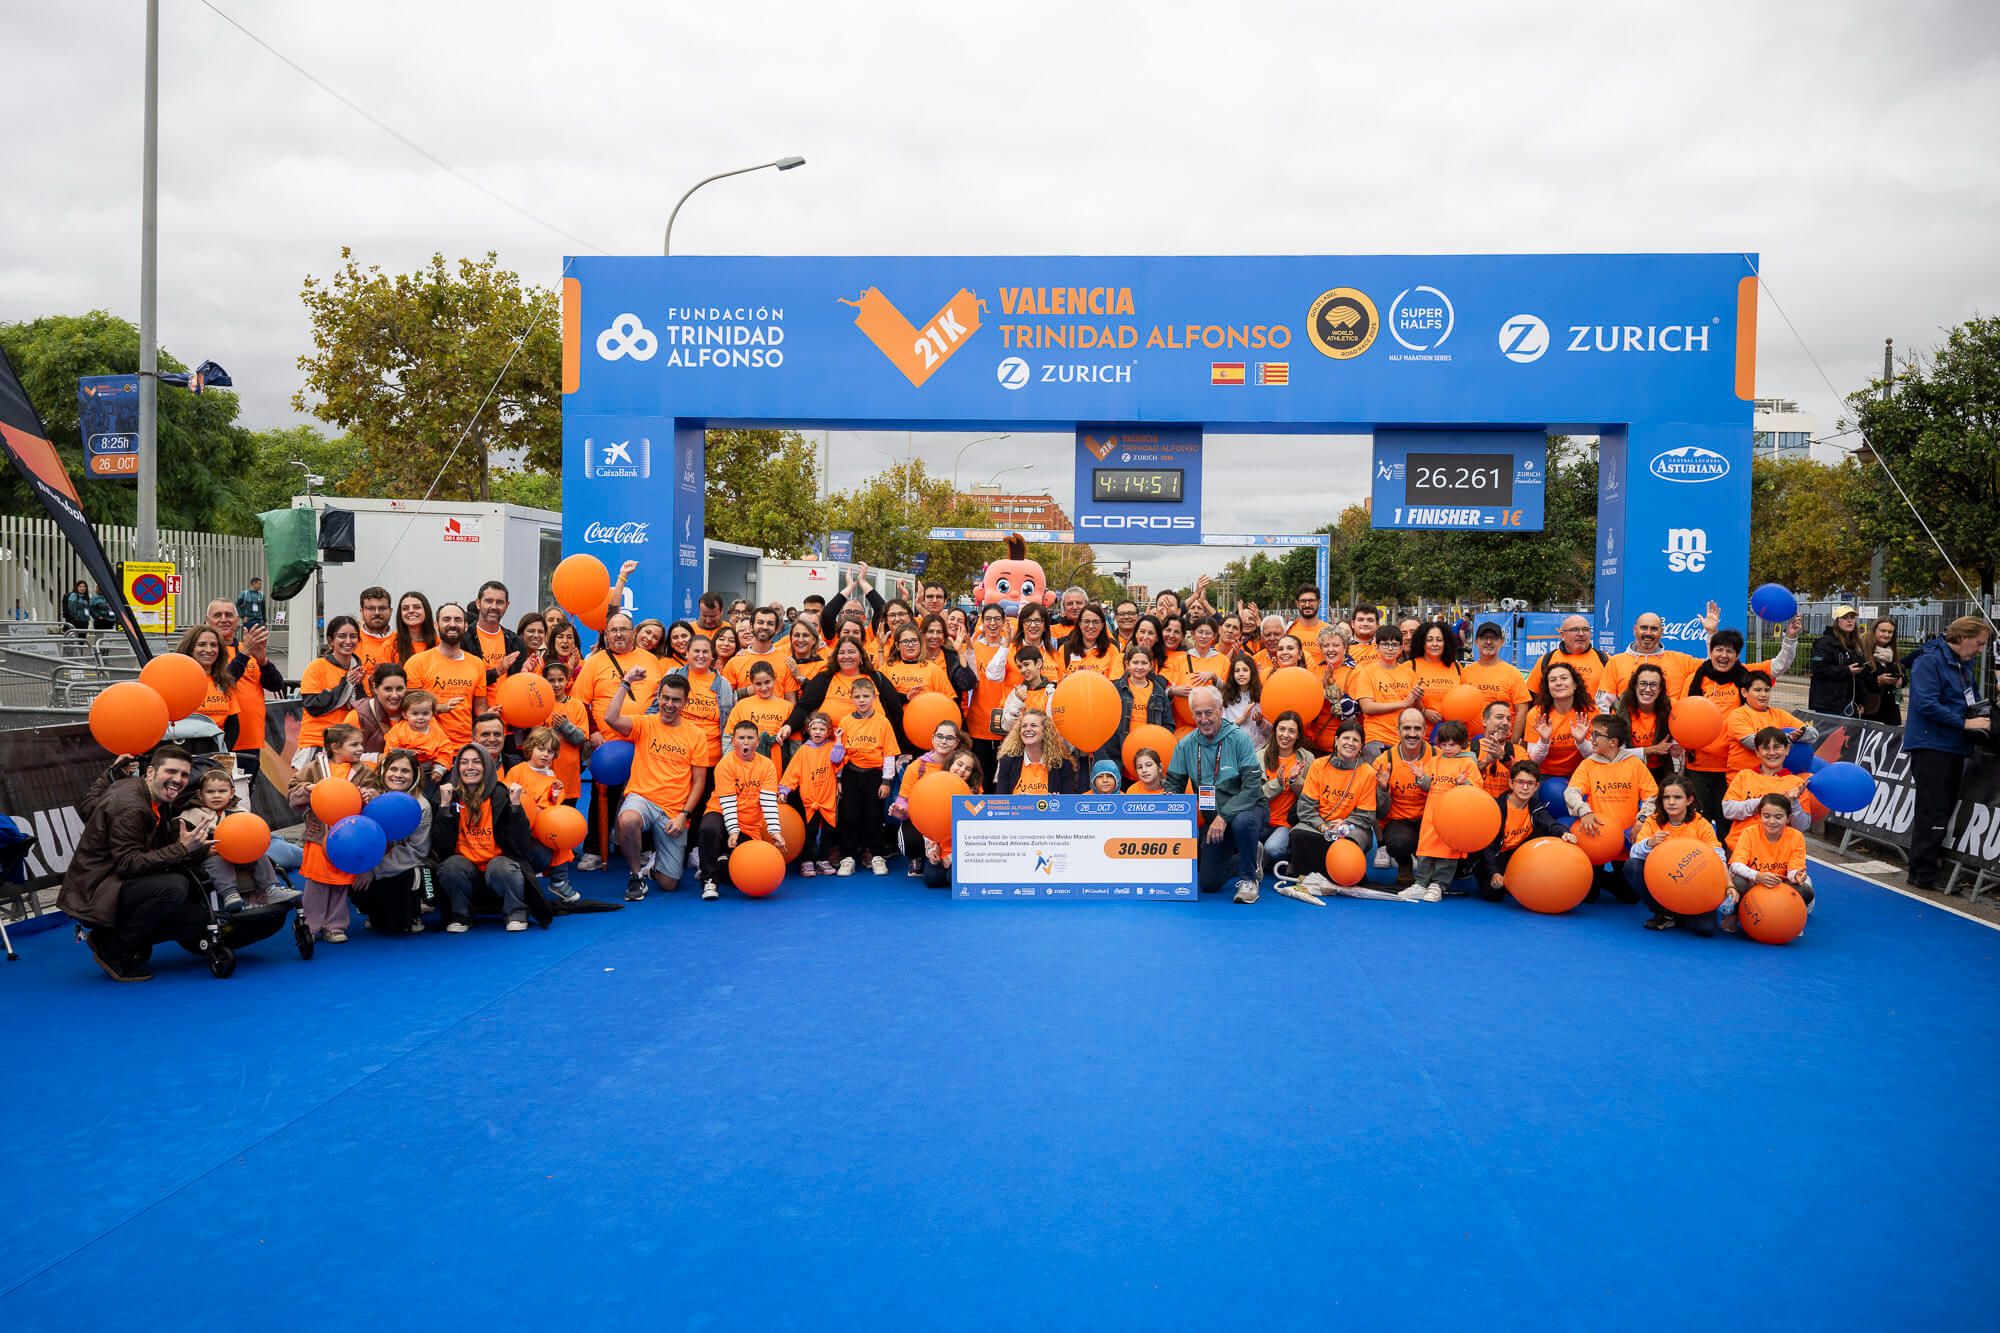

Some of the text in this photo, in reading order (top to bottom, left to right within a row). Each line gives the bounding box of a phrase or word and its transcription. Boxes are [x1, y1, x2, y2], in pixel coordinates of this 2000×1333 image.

[999, 287, 1136, 316] VALENCIA
[1310, 291, 1338, 318] GOLD LABEL
[668, 306, 785, 321] FUNDACIÓN
[1401, 308, 1443, 318] SUPER
[1401, 320, 1442, 329] HALFS
[667, 326, 785, 346] TRINIDAD
[913, 307, 969, 370] 21K
[1000, 325, 1291, 349] TRINIDAD ALFONSO
[1567, 325, 1710, 352] ZURICH
[1341, 349, 1358, 357] ROAD
[1358, 339, 1370, 351] RACE
[667, 348, 784, 368] ALFONSO
[1041, 365, 1132, 383] ZURICH
[101, 437, 129, 449] 8:25h
[1100, 440, 1115, 457] 21K
[1122, 444, 1200, 452] TRINIDAD ALFONSO
[596, 467, 638, 477] CaixaBank
[1656, 459, 1724, 474] ASTURIANA
[1100, 476, 1178, 494] 4:14:51
[1416, 467, 1500, 489] 26.261
[1080, 515, 1195, 529] COROS
[1394, 508, 1402, 525] 1
[1407, 508, 1480, 526] FINISHER
[1502, 509, 1524, 526] 1€
[584, 522, 650, 544] Coca-Cola
[1290, 536, 1321, 544] VALENCIA
[1525, 640, 1548, 656] MÁS
[447, 679, 472, 687] ASPAS
[901, 676, 922, 684] ASPAS
[1388, 682, 1409, 690] ASPAS
[761, 713, 783, 721] ASPAS
[855, 735, 877, 743] ASPAS
[662, 744, 687, 756] ASPAS
[1607, 782, 1632, 791] ASPAS
[1511, 825, 1531, 837] ASPAS
[1118, 842, 1181, 856] 30.960 €
[1679, 848, 1703, 870] ASPAS
[1763, 862, 1788, 870] ASPAS
[423, 868, 435, 899] BIMBA
